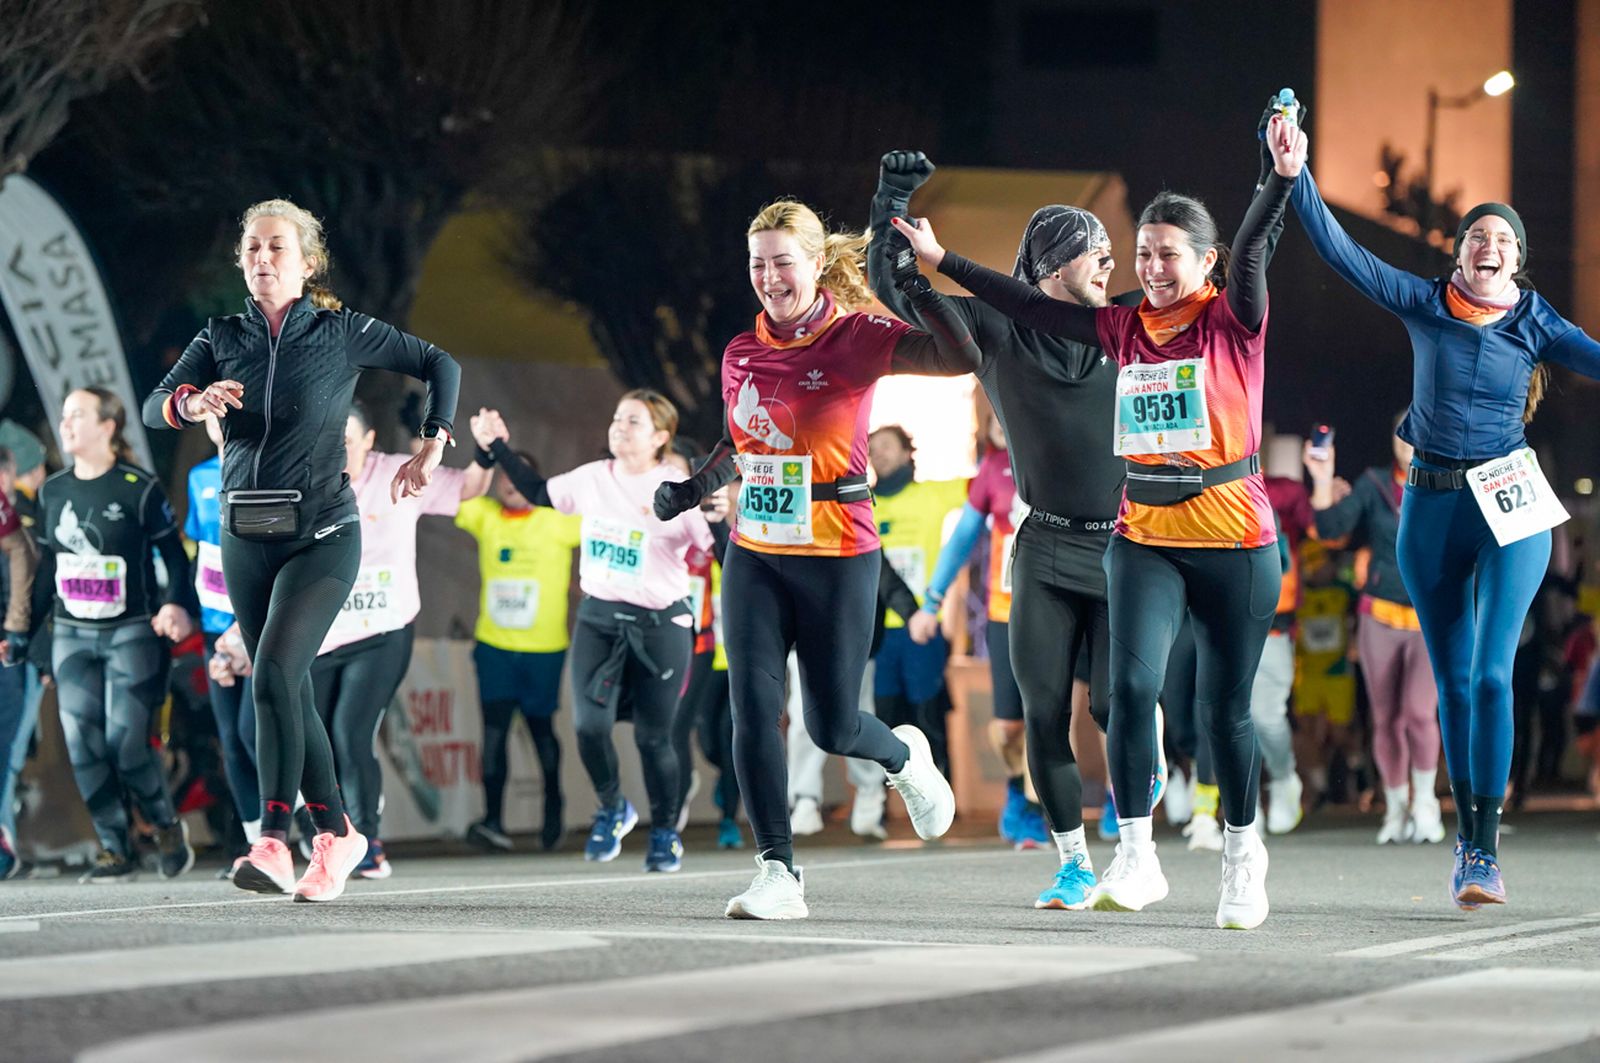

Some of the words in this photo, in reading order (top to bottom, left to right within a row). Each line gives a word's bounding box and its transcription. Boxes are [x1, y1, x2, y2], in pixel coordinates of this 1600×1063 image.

[1133, 392, 1188, 424] 9531
[747, 414, 771, 438] 43
[763, 465, 774, 474] DE
[1488, 463, 1514, 480] NOCHE
[1483, 481, 1502, 494] SAN
[1045, 512, 1071, 528] TIPICK
[1085, 521, 1099, 531] GO
[1101, 521, 1107, 530] 4
[1108, 520, 1117, 530] A
